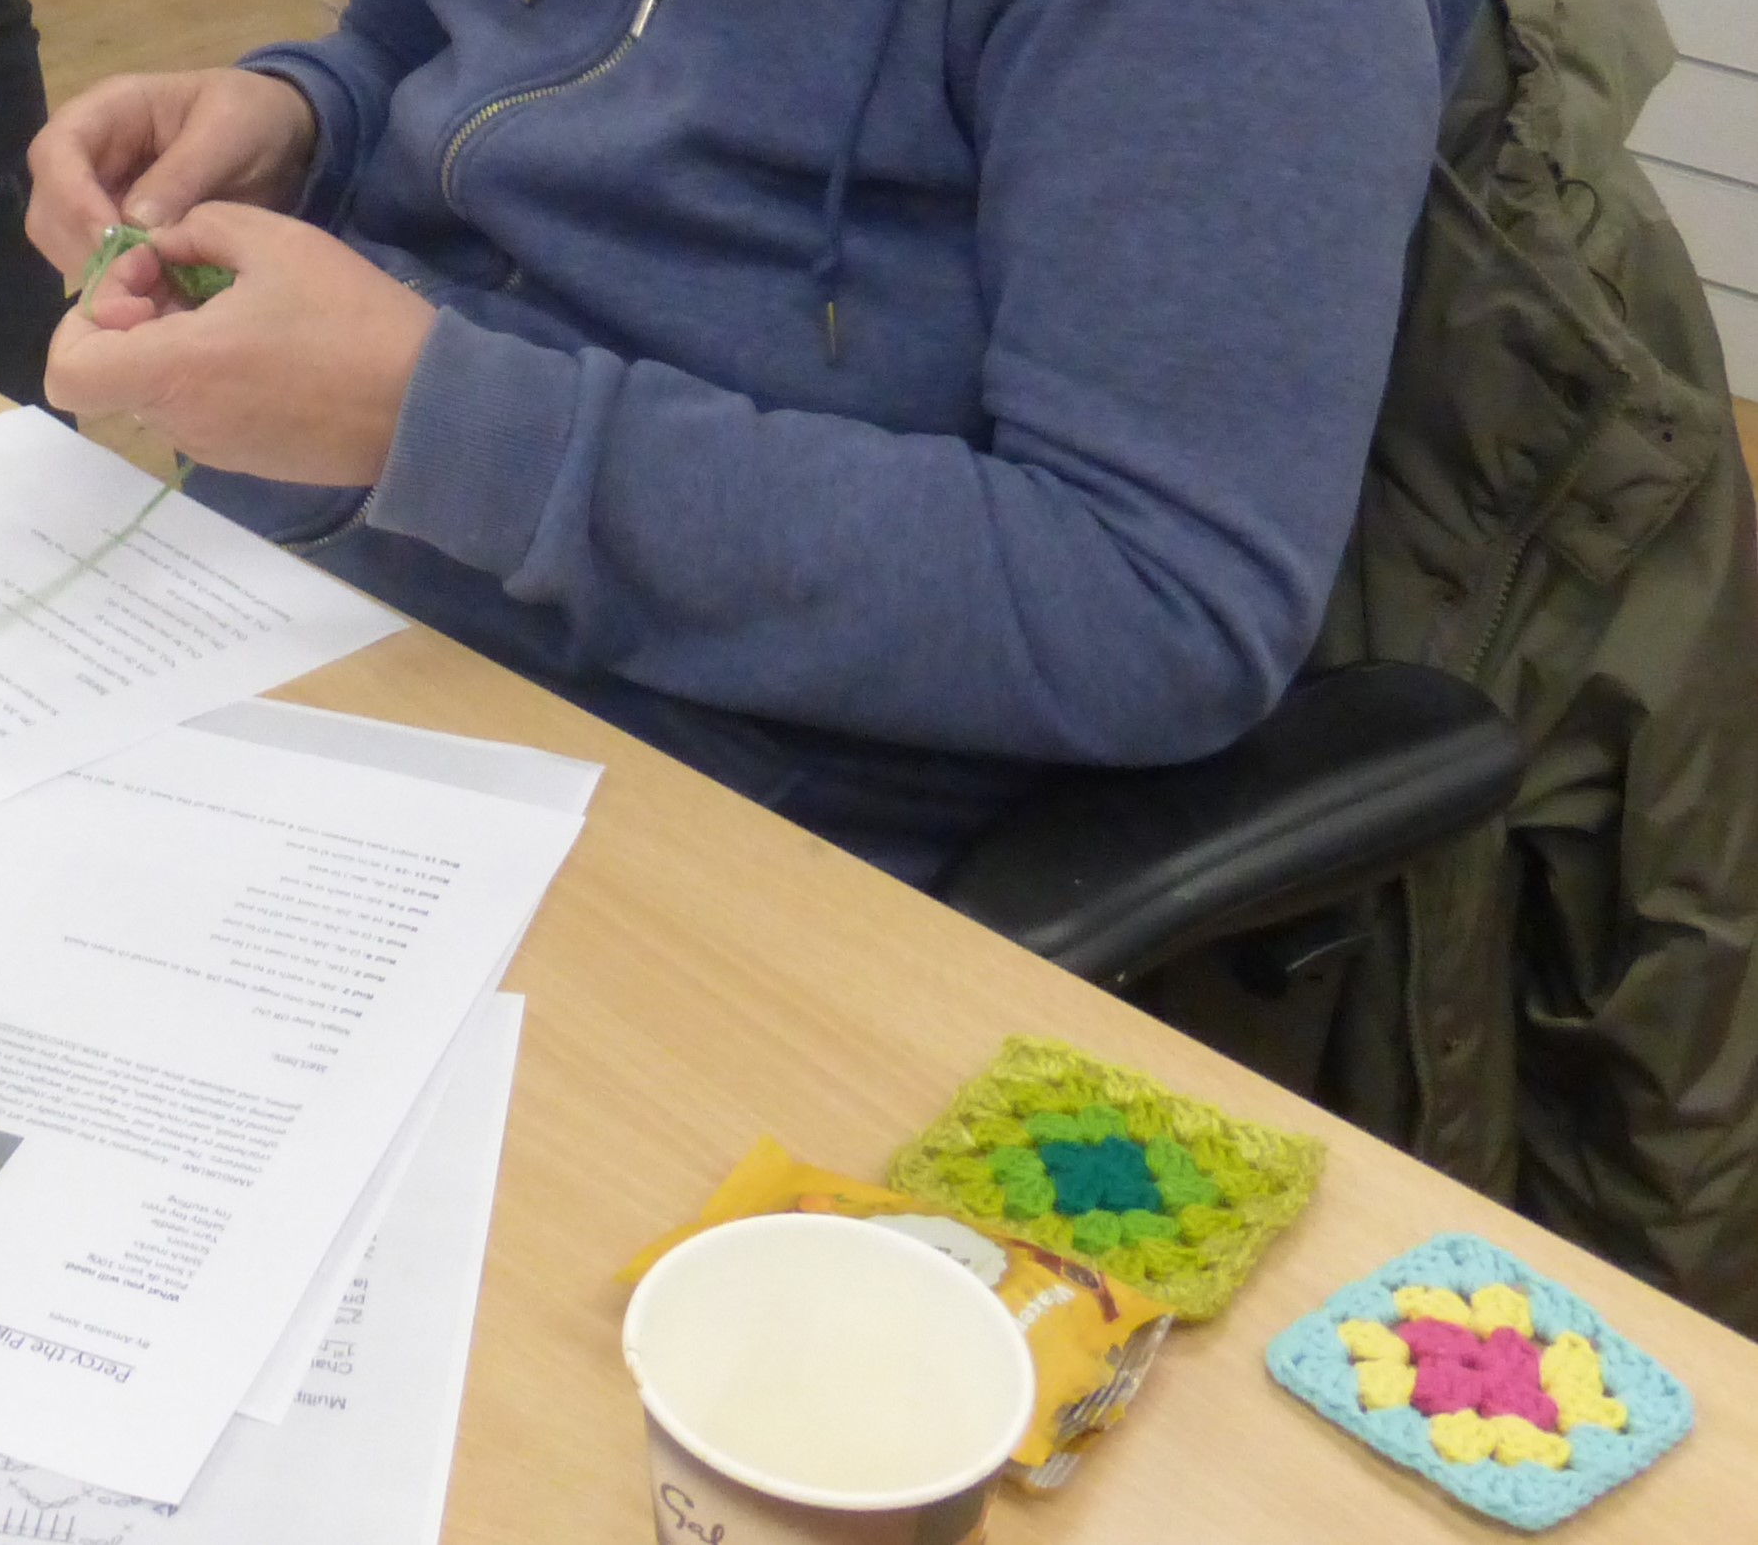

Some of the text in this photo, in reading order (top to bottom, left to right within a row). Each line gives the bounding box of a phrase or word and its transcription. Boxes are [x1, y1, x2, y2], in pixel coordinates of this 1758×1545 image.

[97, 1271, 120, 1284] will
[122, 1277, 145, 1290] you
[146, 1285, 180, 1302] What
[28, 1338, 66, 1363] the
[69, 1349, 132, 1383] Percy
